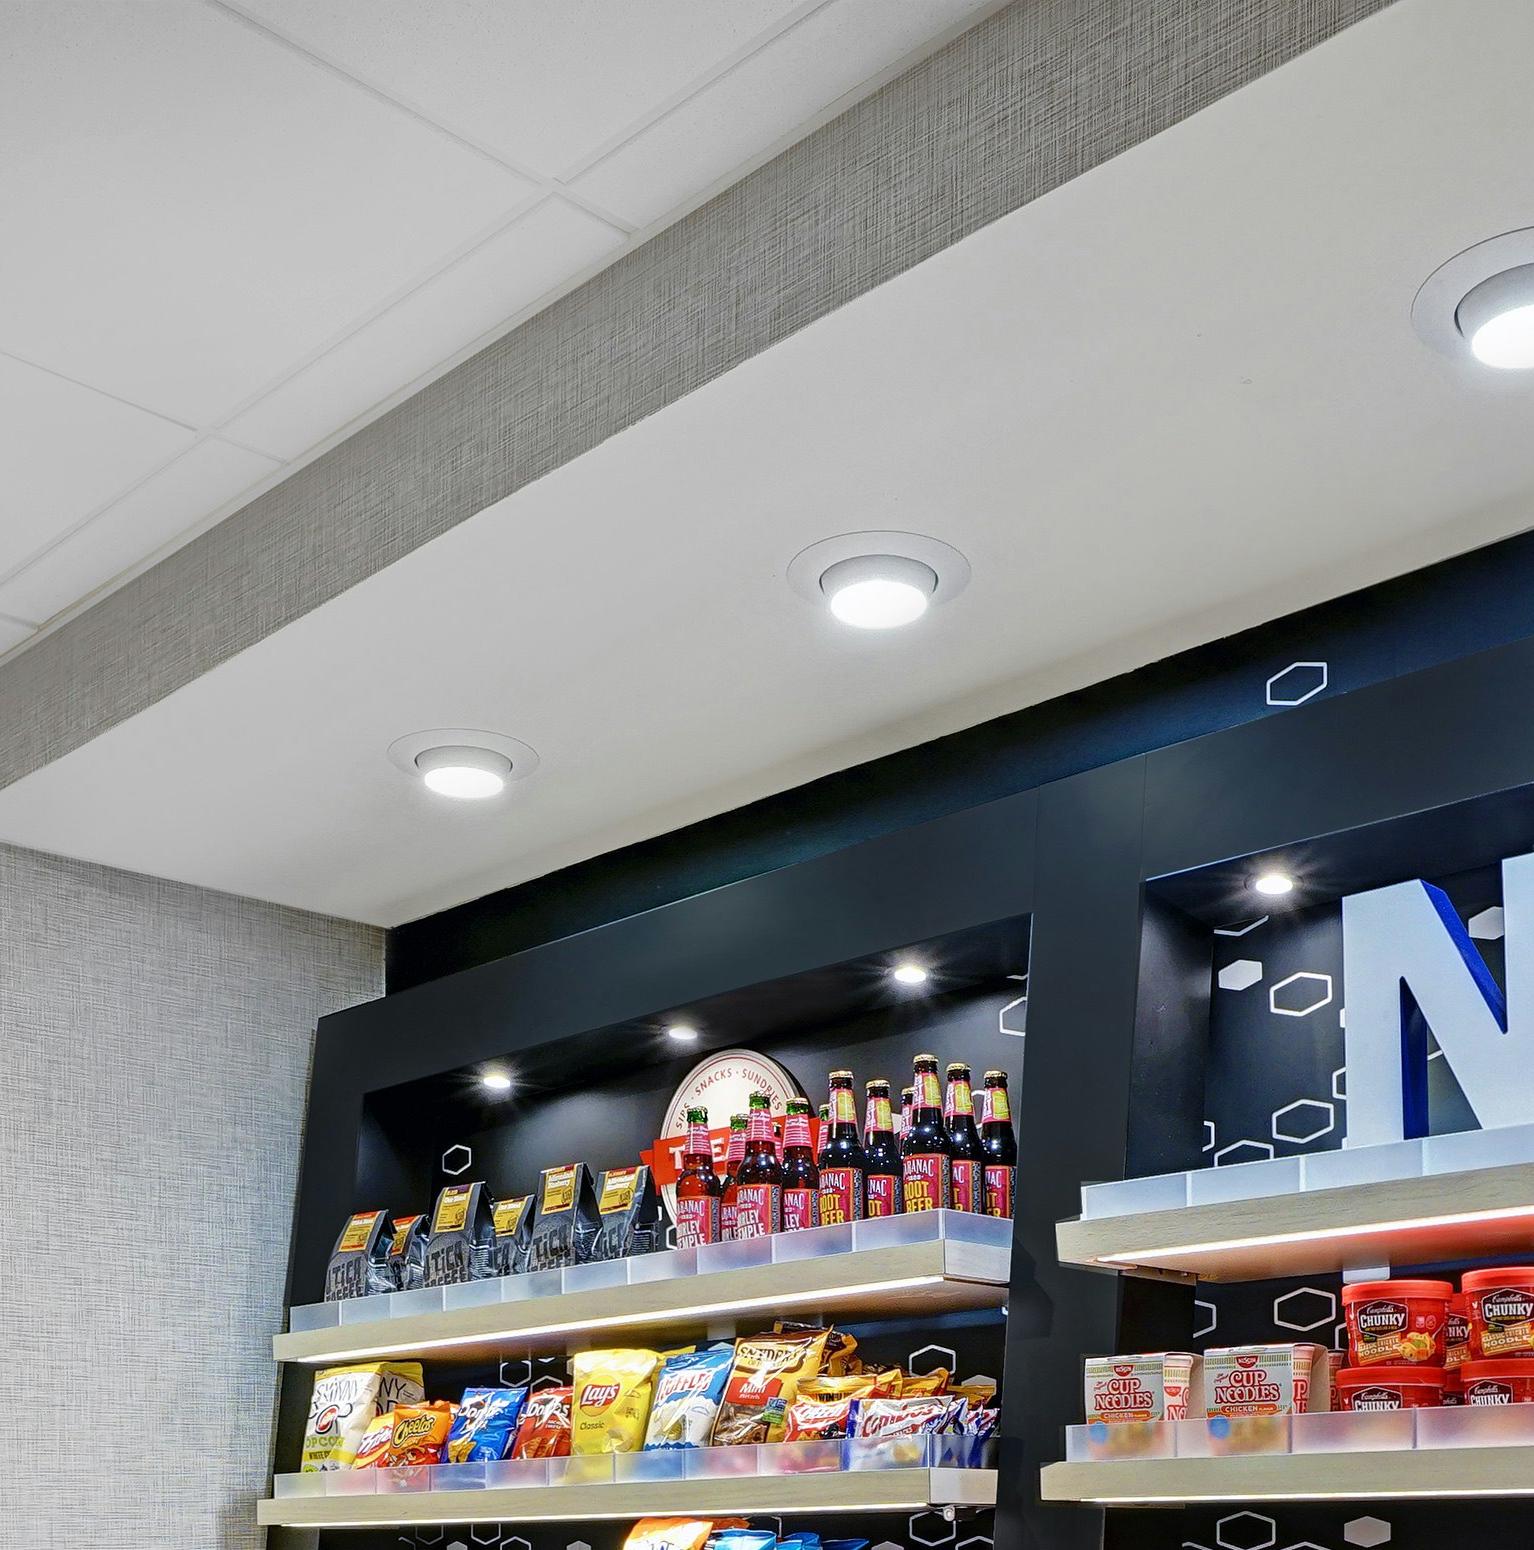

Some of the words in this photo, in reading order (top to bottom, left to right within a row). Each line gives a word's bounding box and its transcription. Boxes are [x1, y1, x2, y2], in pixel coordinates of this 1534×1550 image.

[695, 1068, 732, 1096] SNACKS
[906, 1198, 933, 1212] BEER
[1491, 1294, 1523, 1304] Campbell's
[1484, 1302, 1534, 1318] CHUNKY
[1360, 1313, 1406, 1329] CHUNKY
[1483, 1334, 1531, 1348] NOODLE
[1359, 1343, 1401, 1358] NOODLE
[1107, 1377, 1142, 1396] CUP
[1229, 1369, 1268, 1388] CUP
[580, 1382, 620, 1407] Lay's
[657, 1372, 712, 1402] RUFFLES
[1214, 1383, 1281, 1405] NOODLES
[1094, 1391, 1154, 1411] NOODLES
[1470, 1393, 1510, 1407] CHUNKY
[1225, 1405, 1258, 1413] CHICKEN
[393, 1413, 437, 1449] Cheetos
[580, 1421, 605, 1431] Classic
